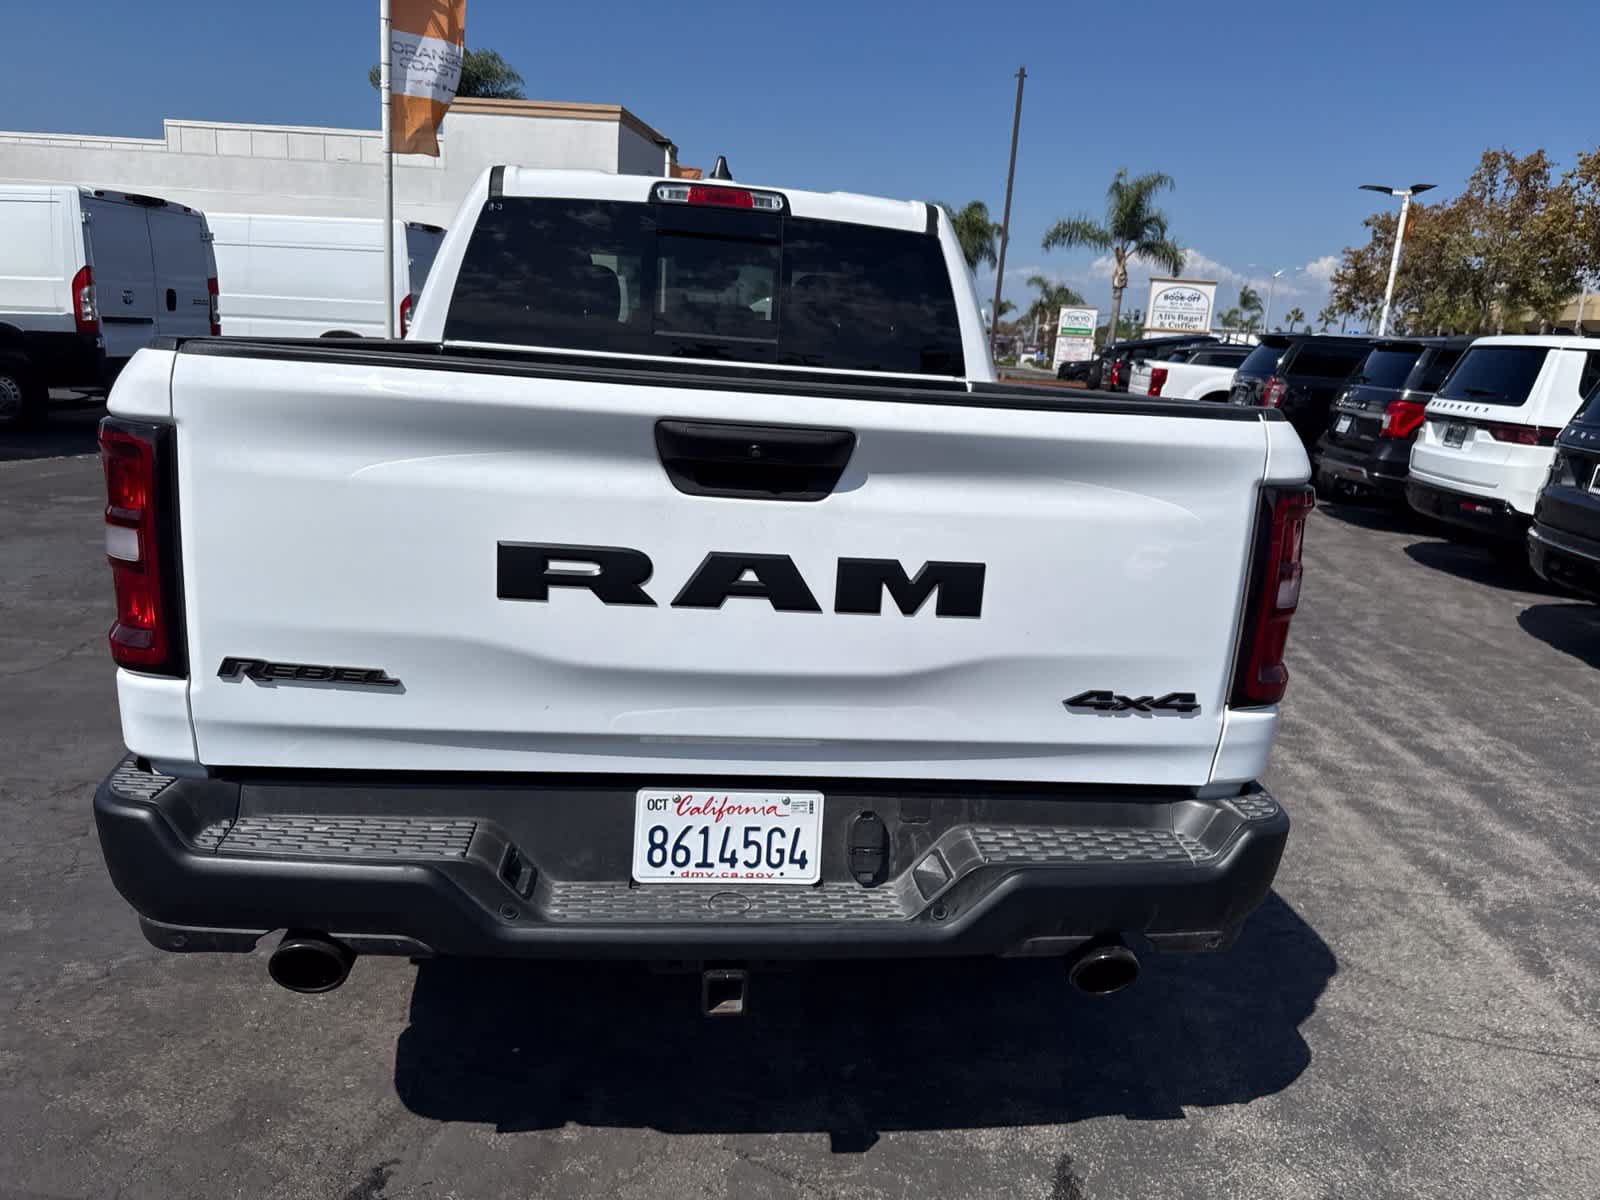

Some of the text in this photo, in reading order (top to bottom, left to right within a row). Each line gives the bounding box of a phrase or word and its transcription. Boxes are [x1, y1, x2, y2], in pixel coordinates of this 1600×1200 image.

[399, 57, 457, 79] COAST
[1168, 321, 1199, 329] Coffee
[496, 540, 987, 620] RAM
[647, 798, 668, 811] OCT
[675, 794, 790, 823] California
[647, 824, 808, 871] 86145G4
[680, 870, 775, 879] dmv.ca.gov
